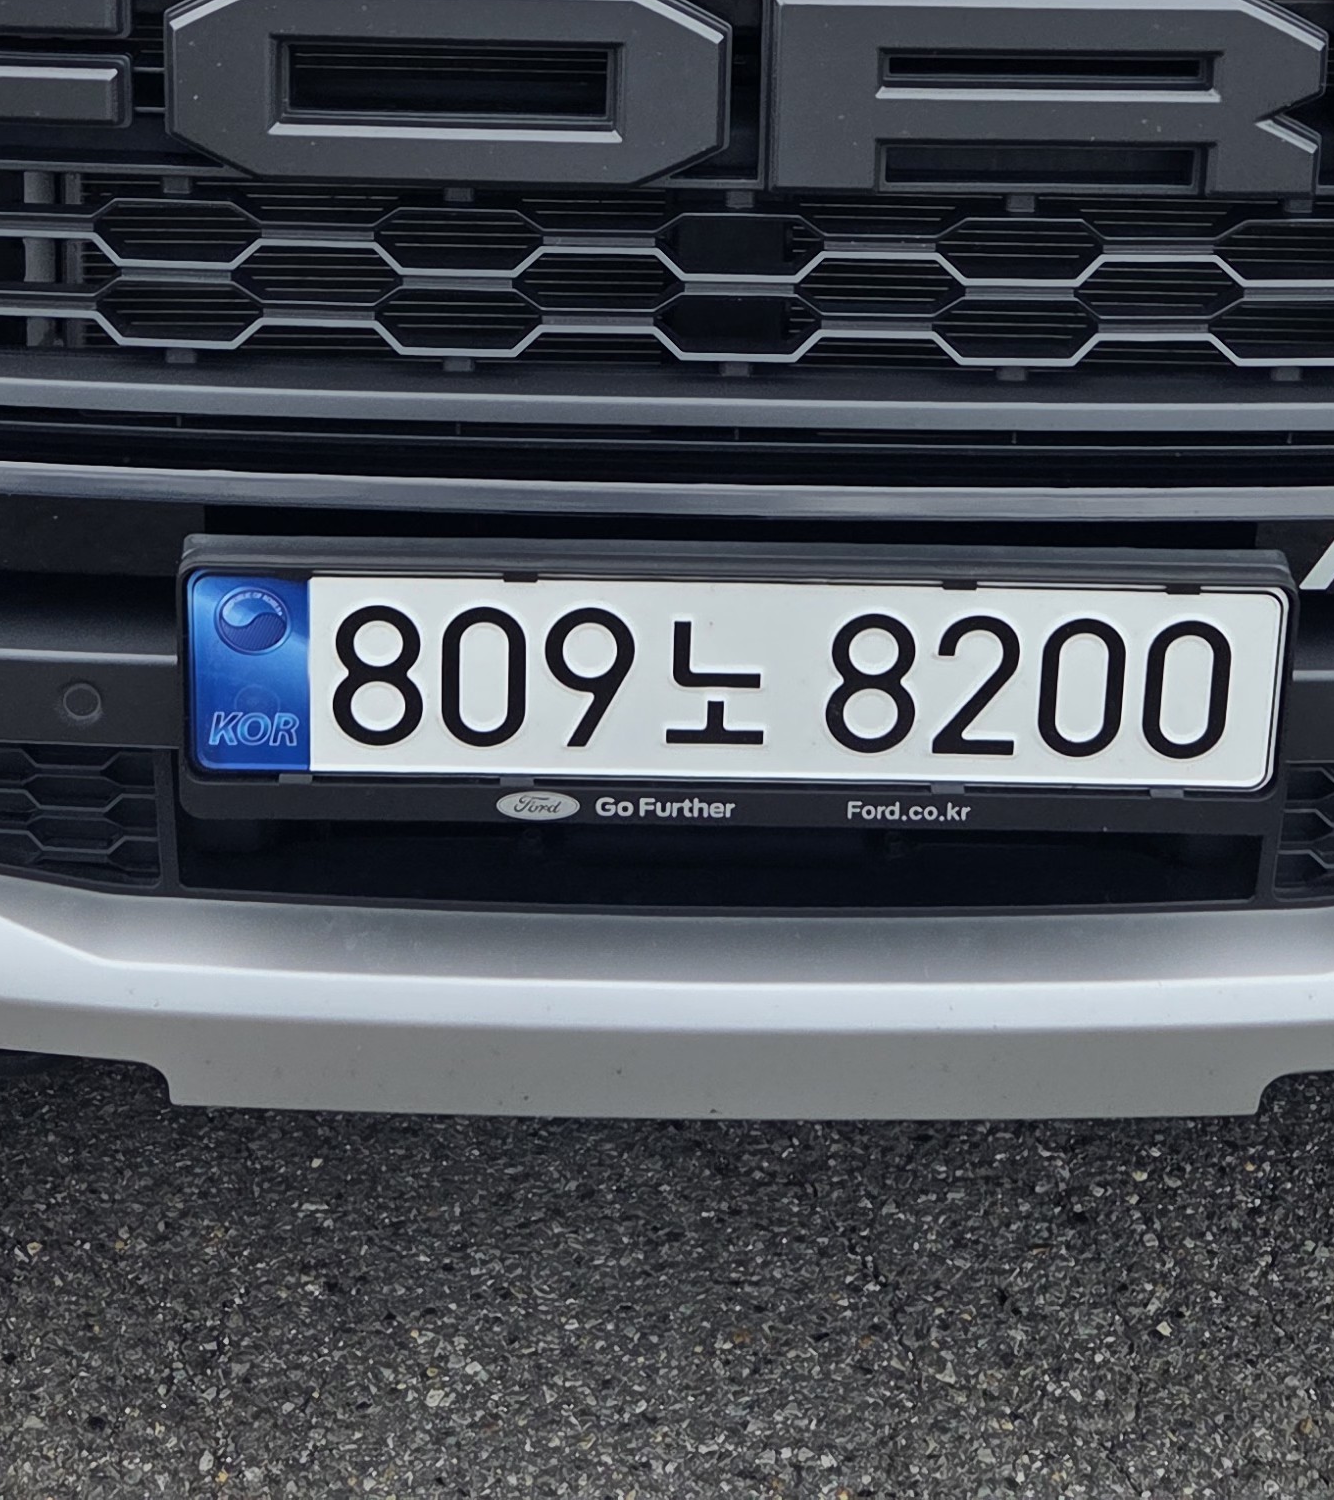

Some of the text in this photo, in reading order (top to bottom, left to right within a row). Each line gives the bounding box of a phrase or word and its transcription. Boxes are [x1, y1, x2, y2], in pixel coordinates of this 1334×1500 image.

[331, 605, 1232, 761] 809노 8200
[208, 711, 300, 747] KOR
[595, 797, 634, 818] Go
[639, 797, 736, 819] Further
[847, 801, 971, 822] Ford.co.kr
